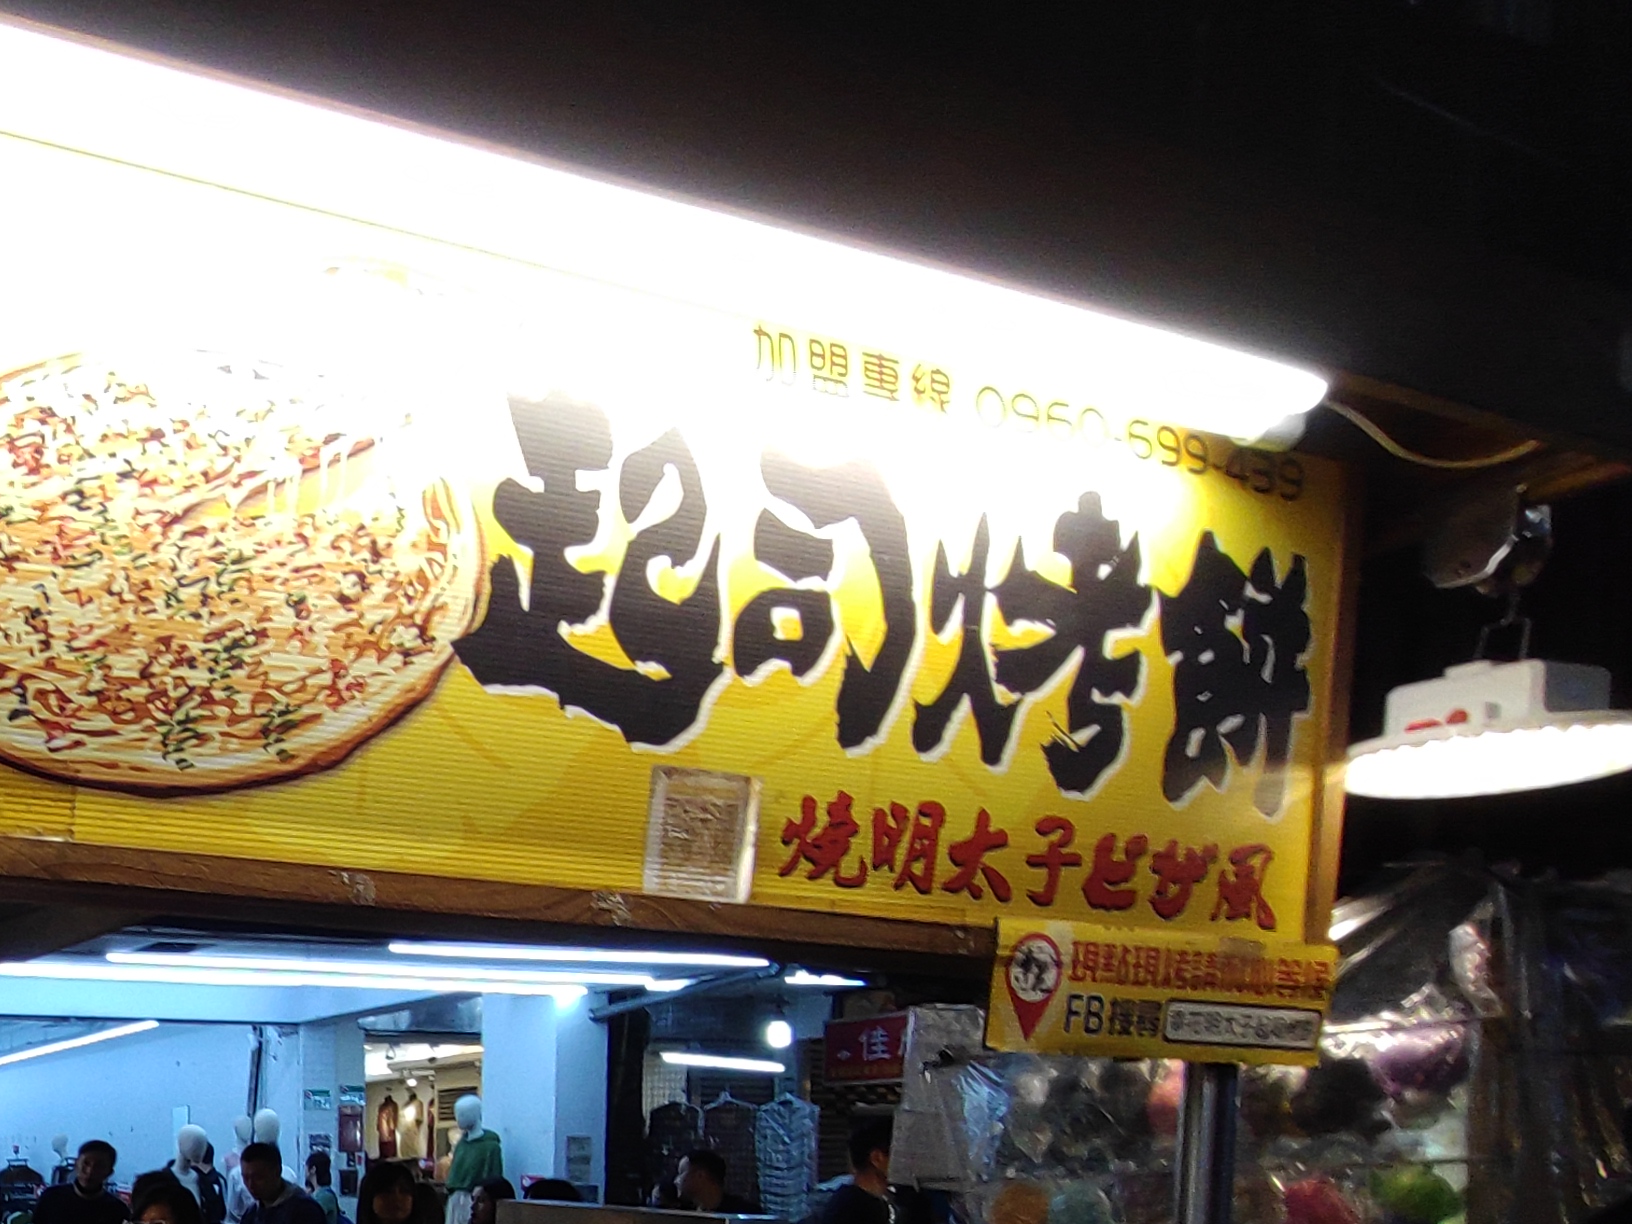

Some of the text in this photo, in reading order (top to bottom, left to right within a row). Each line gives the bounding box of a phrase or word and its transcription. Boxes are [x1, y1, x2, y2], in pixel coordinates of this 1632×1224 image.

[973, 384, 1306, 506] 0960-699-439
[451, 392, 1313, 822] 起司烤餅
[1064, 993, 1106, 1034] FB
